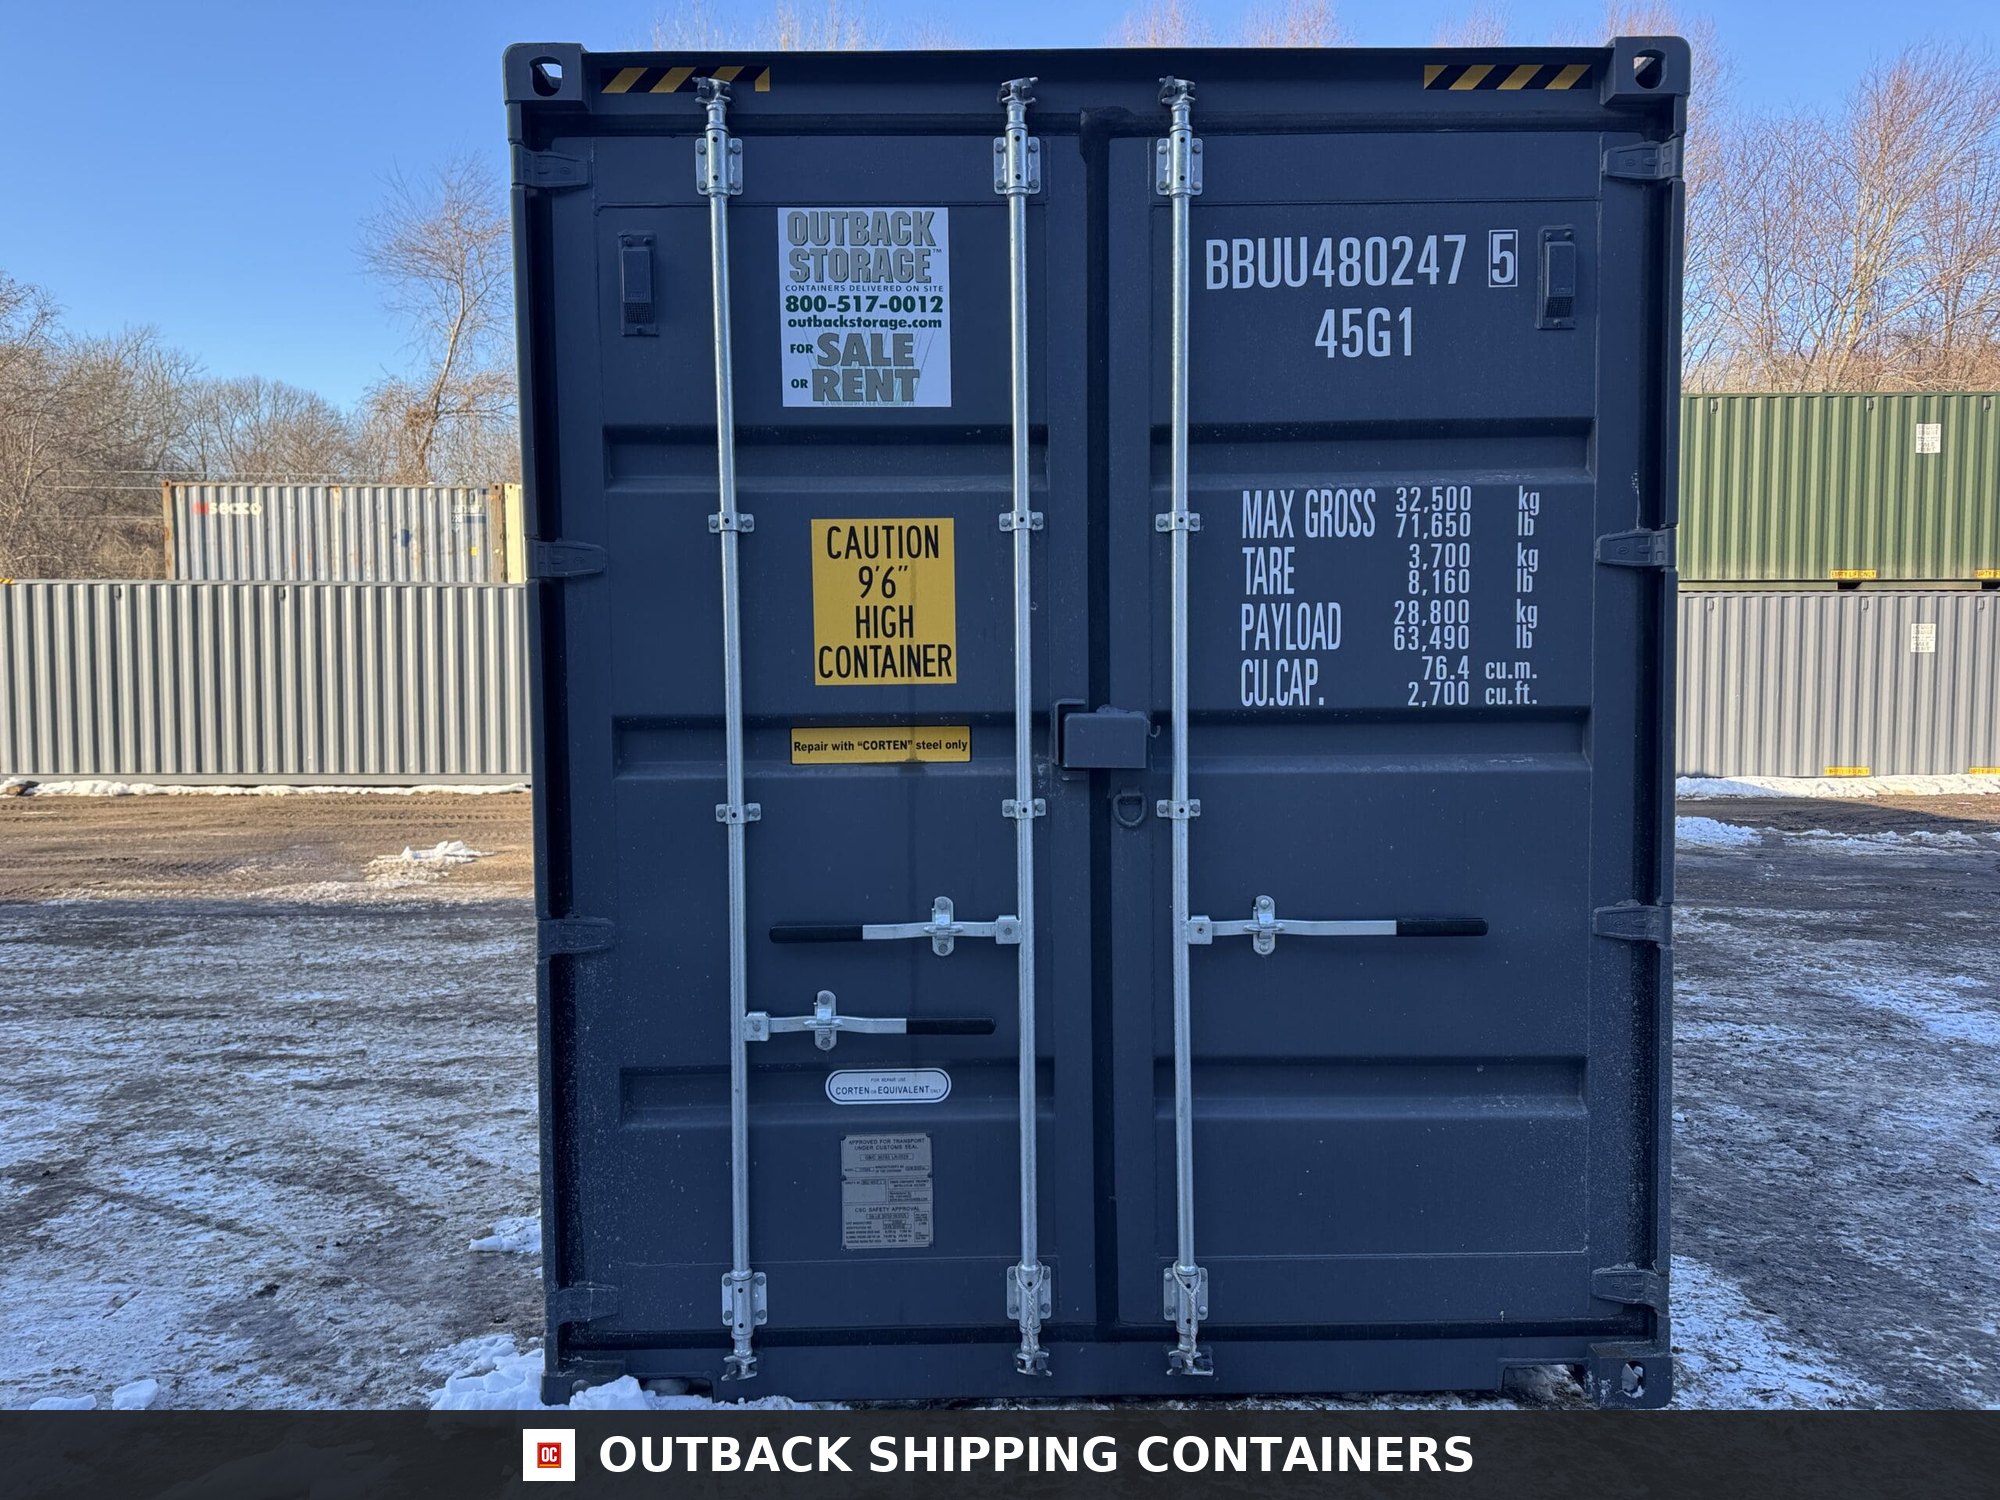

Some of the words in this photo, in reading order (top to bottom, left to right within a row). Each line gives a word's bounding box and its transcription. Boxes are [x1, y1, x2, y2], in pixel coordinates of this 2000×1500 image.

[787, 210, 936, 247] OUTBACK
[788, 248, 932, 283] STORAGE
[1206, 234, 1467, 290] BBUU480247
[1491, 232, 1515, 285] 5
[785, 284, 846, 292] CONTAINERS
[849, 284, 902, 292] DELIVERED
[924, 285, 944, 293] SITE
[785, 295, 944, 313] 800-517-0012
[787, 314, 942, 331] outbackstorage.com
[1314, 307, 1413, 359] 45G1
[790, 344, 814, 354] FOR
[816, 332, 915, 367] SALE
[790, 379, 808, 389] OR
[812, 368, 920, 402] RENT
[1241, 489, 1295, 539] MAX
[1304, 488, 1376, 538] GROSS
[1395, 485, 1472, 513] 32,500
[1517, 485, 1540, 516] kg
[1395, 511, 1471, 540] 71,650
[1517, 511, 1535, 537] lb
[826, 524, 939, 560] CAUTION
[1241, 546, 1296, 595] TARE
[1408, 542, 1471, 571] 3,700
[1516, 542, 1539, 573] kg
[1407, 568, 1471, 597] 8,160
[1515, 568, 1533, 593] lb
[855, 604, 914, 639] HIGH
[1240, 601, 1342, 651] PAYLOAD
[1394, 598, 1470, 627] 28,800
[1515, 598, 1539, 629] kg
[1393, 624, 1470, 653] 63,490
[1515, 624, 1533, 649] lb
[818, 644, 952, 679] CONTAINER
[1240, 657, 1325, 707] CU.CAP.
[1421, 654, 1470, 681] 76.4
[1484, 660, 1539, 680] cu.m.
[1407, 680, 1470, 708] 2,700
[1484, 680, 1539, 706] cu.ft.
[793, 741, 828, 754] Repair
[831, 740, 854, 751] with
[915, 739, 942, 750] steel
[945, 739, 968, 751] only
[835, 1086, 870, 1096] CORTEN
[877, 1085, 930, 1095] EQUIVALENT
